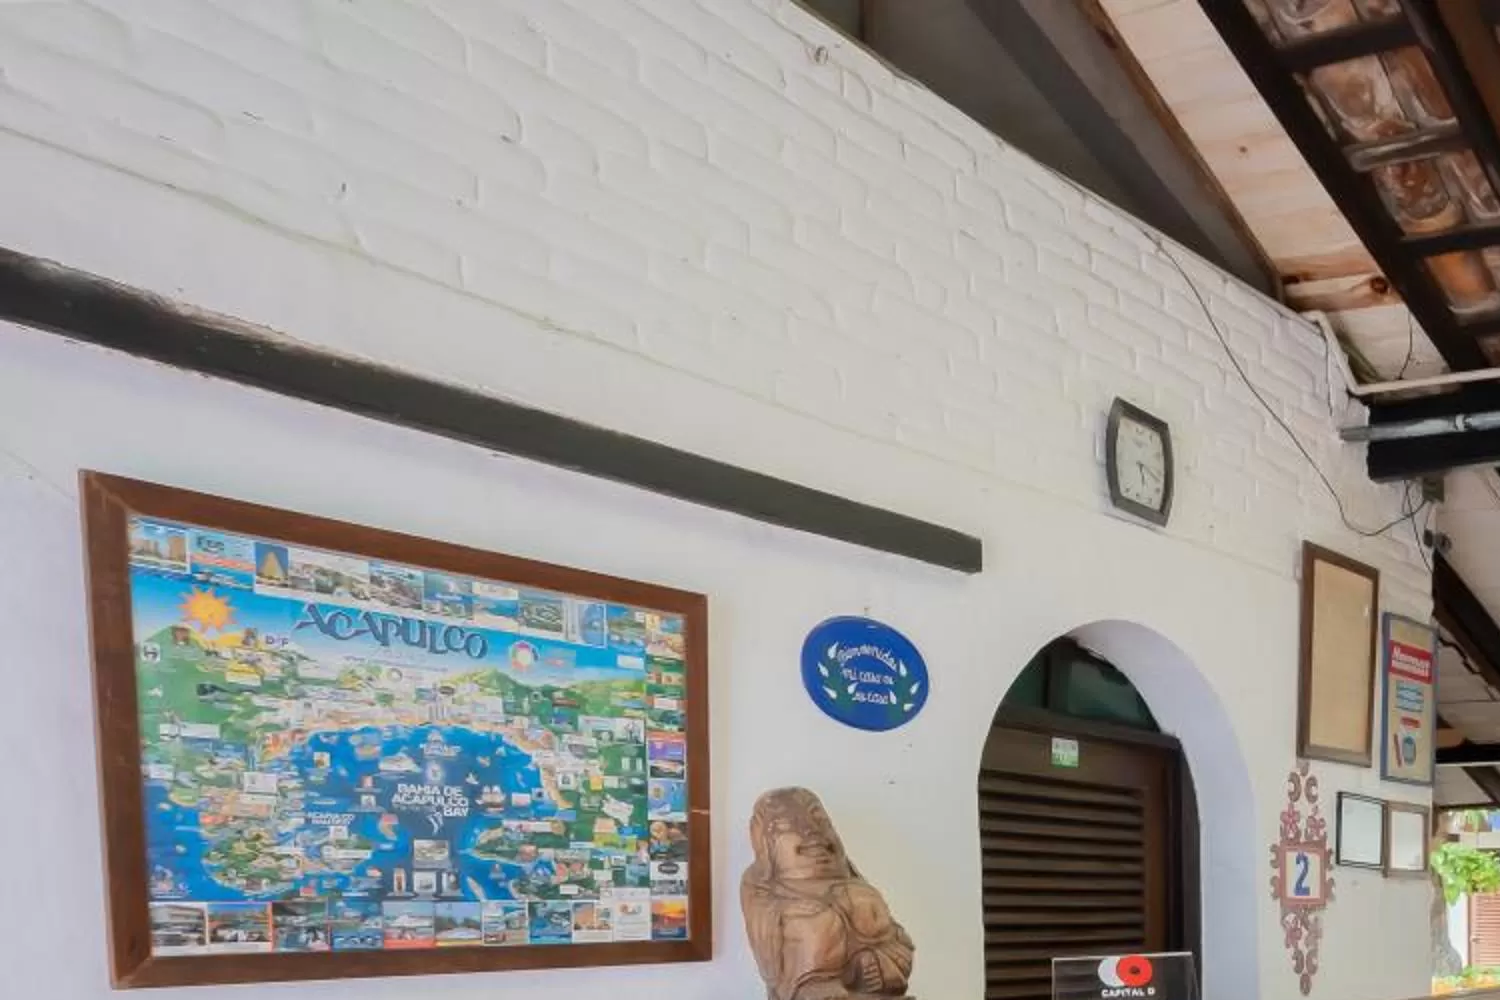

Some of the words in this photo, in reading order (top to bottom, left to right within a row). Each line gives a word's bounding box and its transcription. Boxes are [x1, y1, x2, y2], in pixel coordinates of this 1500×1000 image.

[294, 603, 488, 659] ACAPULCO
[443, 807, 469, 816] BAY
[1295, 852, 1310, 896] 2
[1101, 987, 1145, 998] CAPITAL
